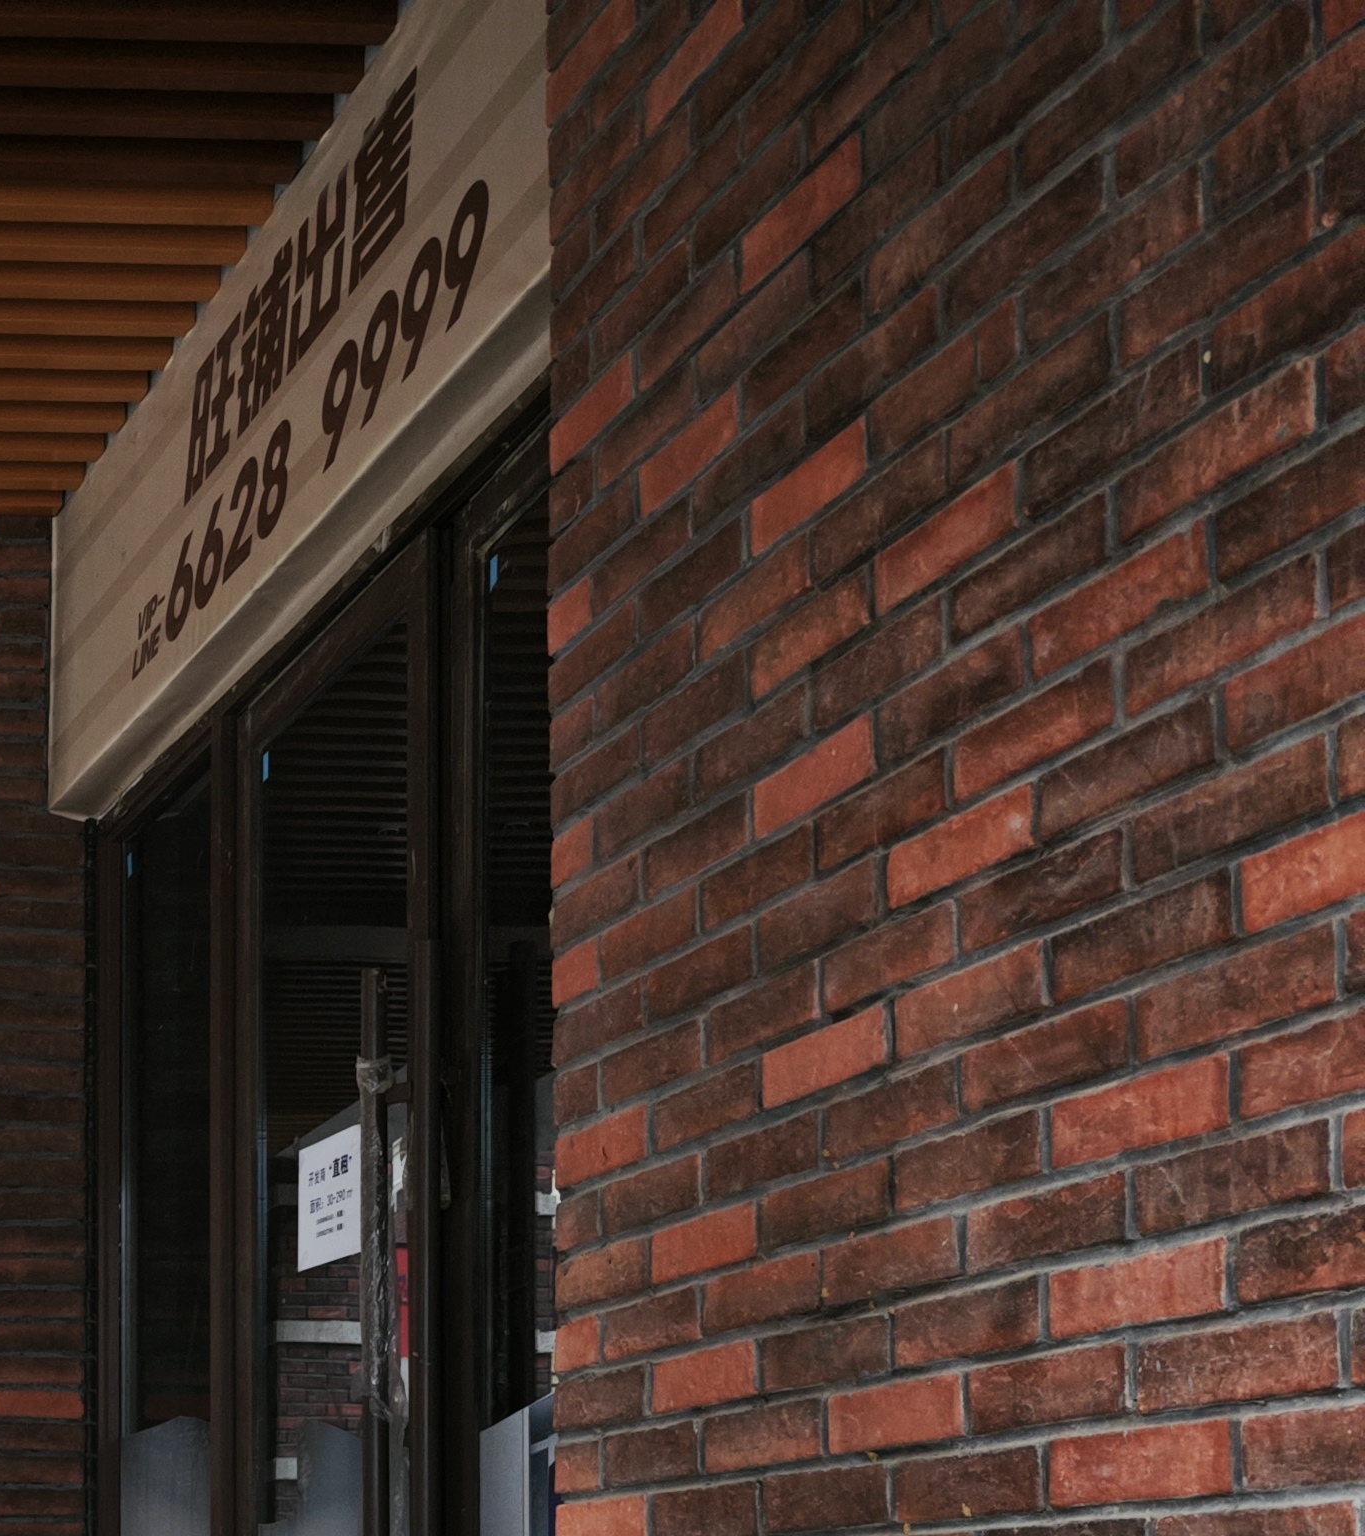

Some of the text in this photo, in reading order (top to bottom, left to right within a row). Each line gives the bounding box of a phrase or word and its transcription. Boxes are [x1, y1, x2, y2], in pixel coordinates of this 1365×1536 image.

[166, 179, 489, 642] 6628 9999
[184, 65, 418, 507] 旺铺出售
[132, 623, 162, 681] LINE
